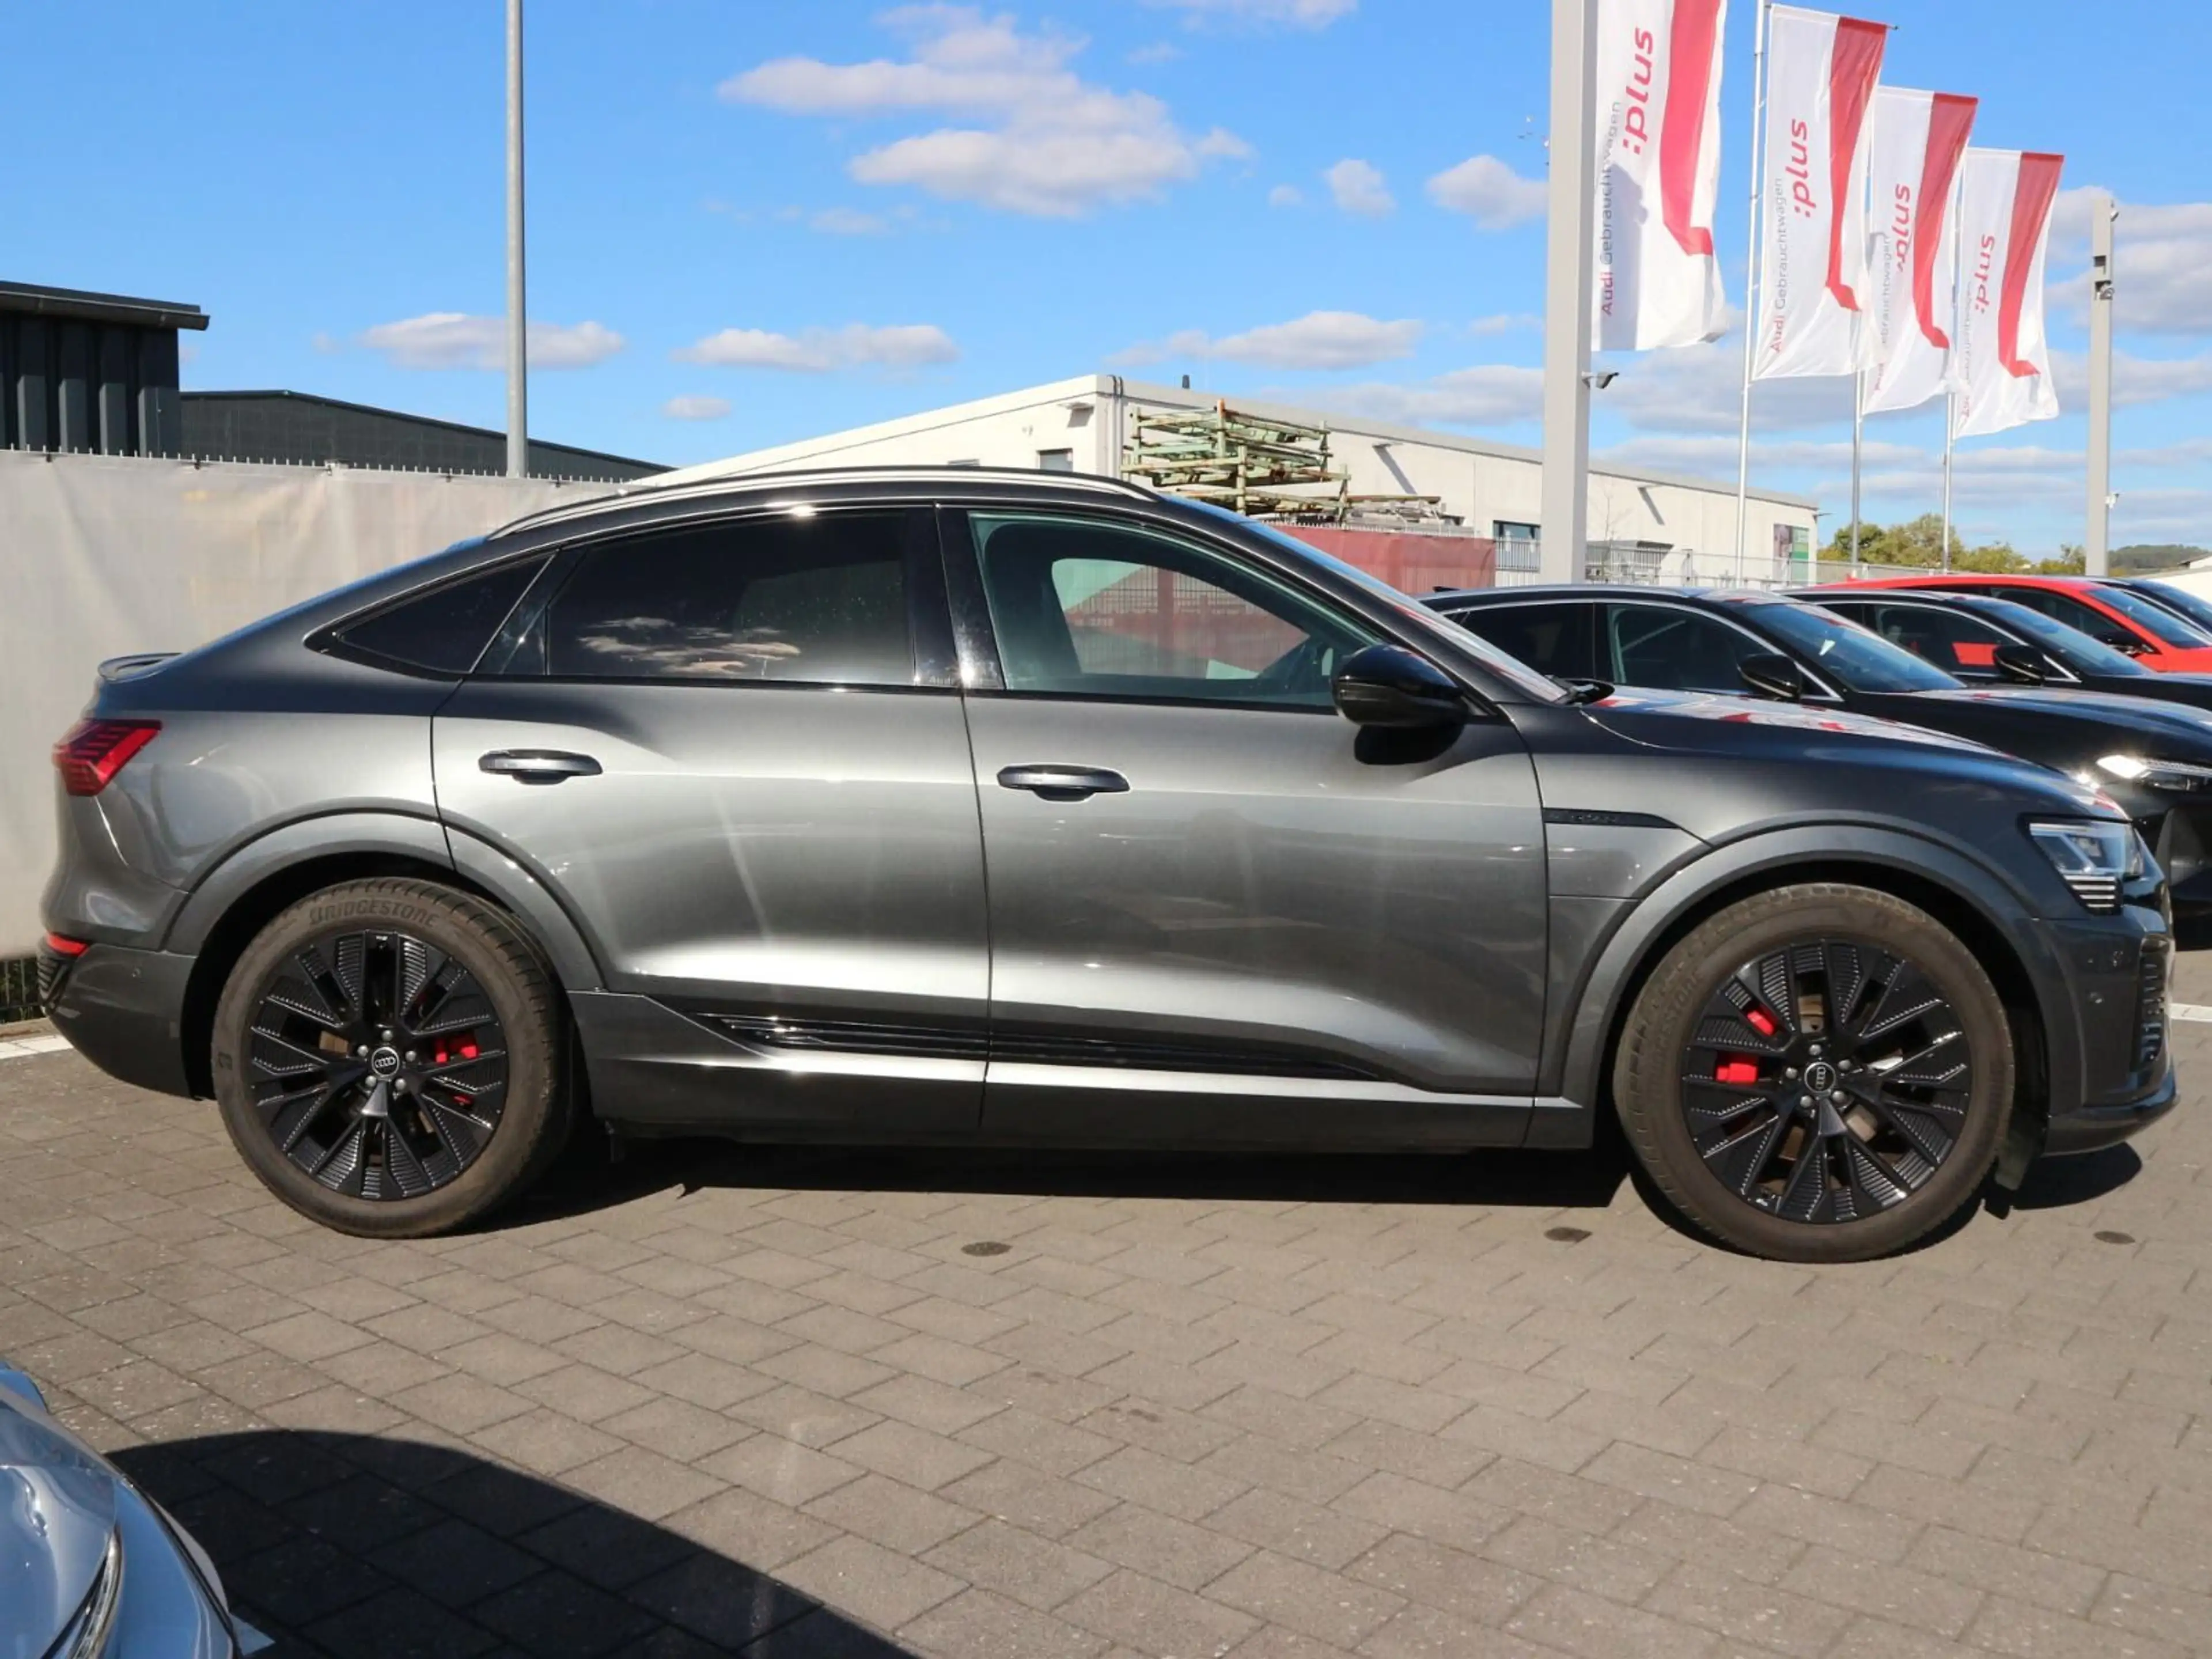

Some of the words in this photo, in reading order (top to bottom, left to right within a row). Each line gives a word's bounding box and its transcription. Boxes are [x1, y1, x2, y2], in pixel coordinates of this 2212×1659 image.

[1623, 27, 1653, 155] :plus
[1786, 119, 1816, 218] :plus
[1601, 271, 1613, 316] Audi
[1774, 178, 1787, 310] Gebrauchtwagen
[1770, 315, 1785, 353] Audi
